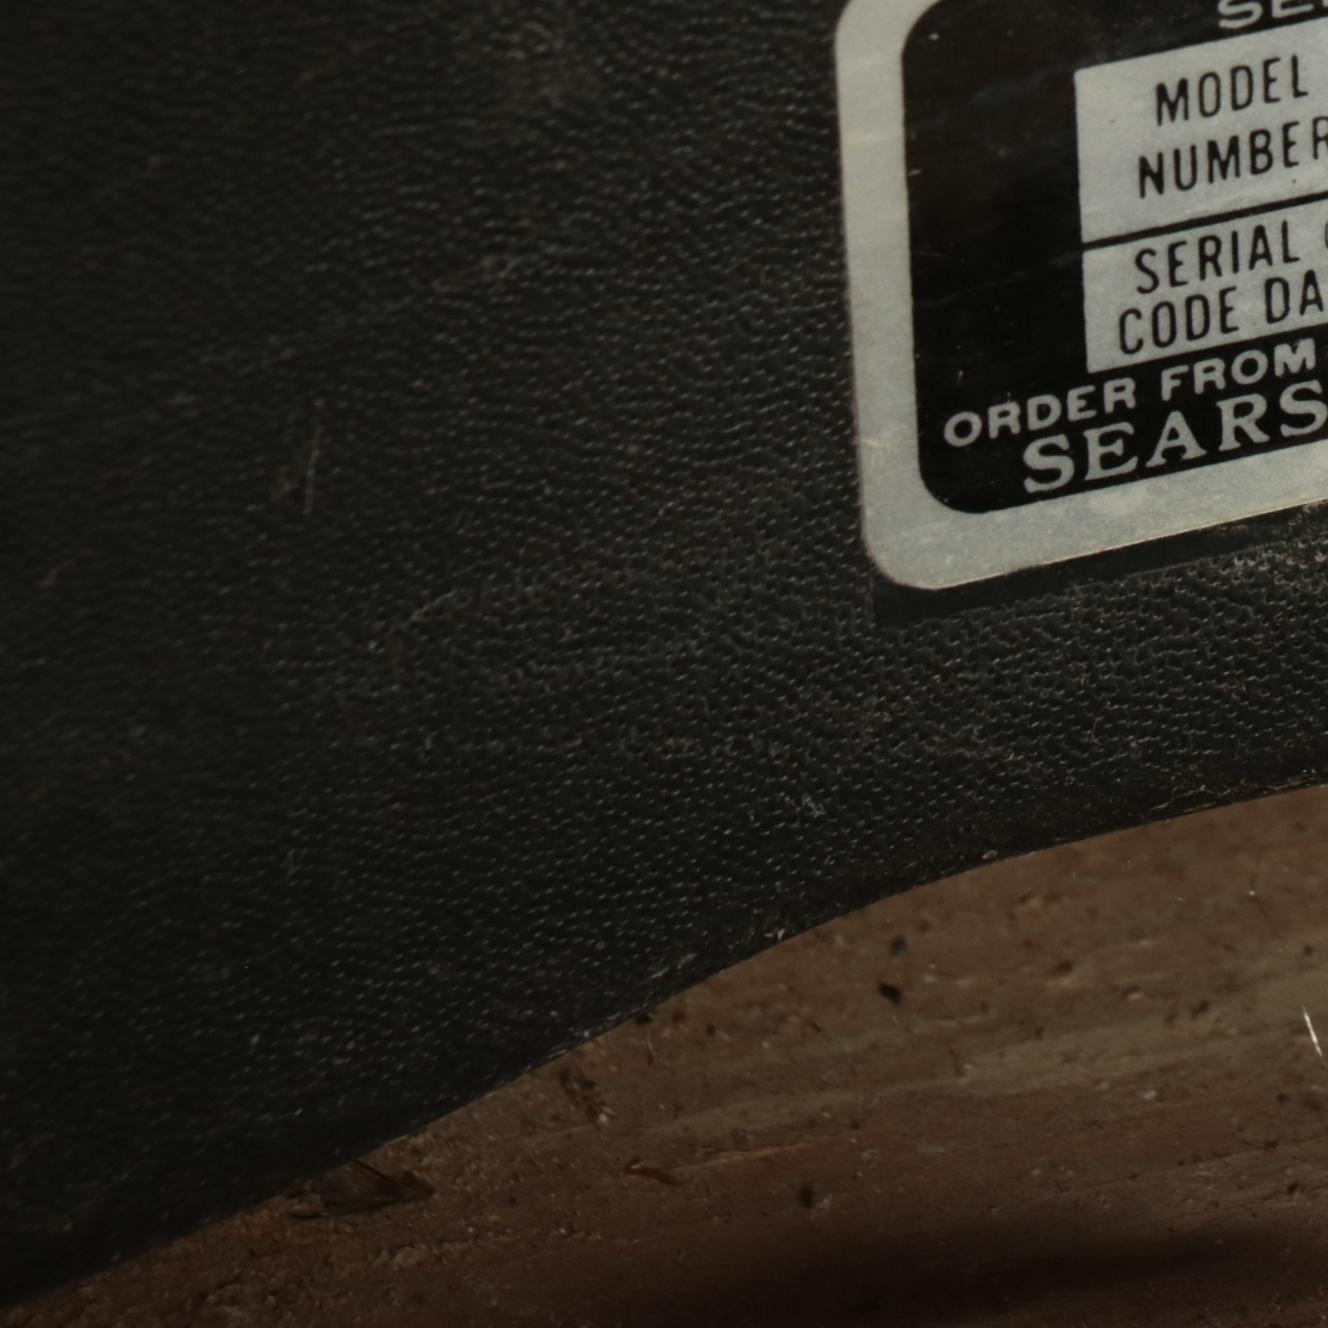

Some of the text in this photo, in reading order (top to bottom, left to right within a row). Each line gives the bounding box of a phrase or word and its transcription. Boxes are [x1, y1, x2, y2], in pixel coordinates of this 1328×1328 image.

[1155, 54, 1308, 126] MODEL
[1134, 218, 1299, 294] SERIAL
[1117, 288, 1239, 356] CODE
[943, 377, 1136, 446] ORDER
[1161, 340, 1317, 400] FROM
